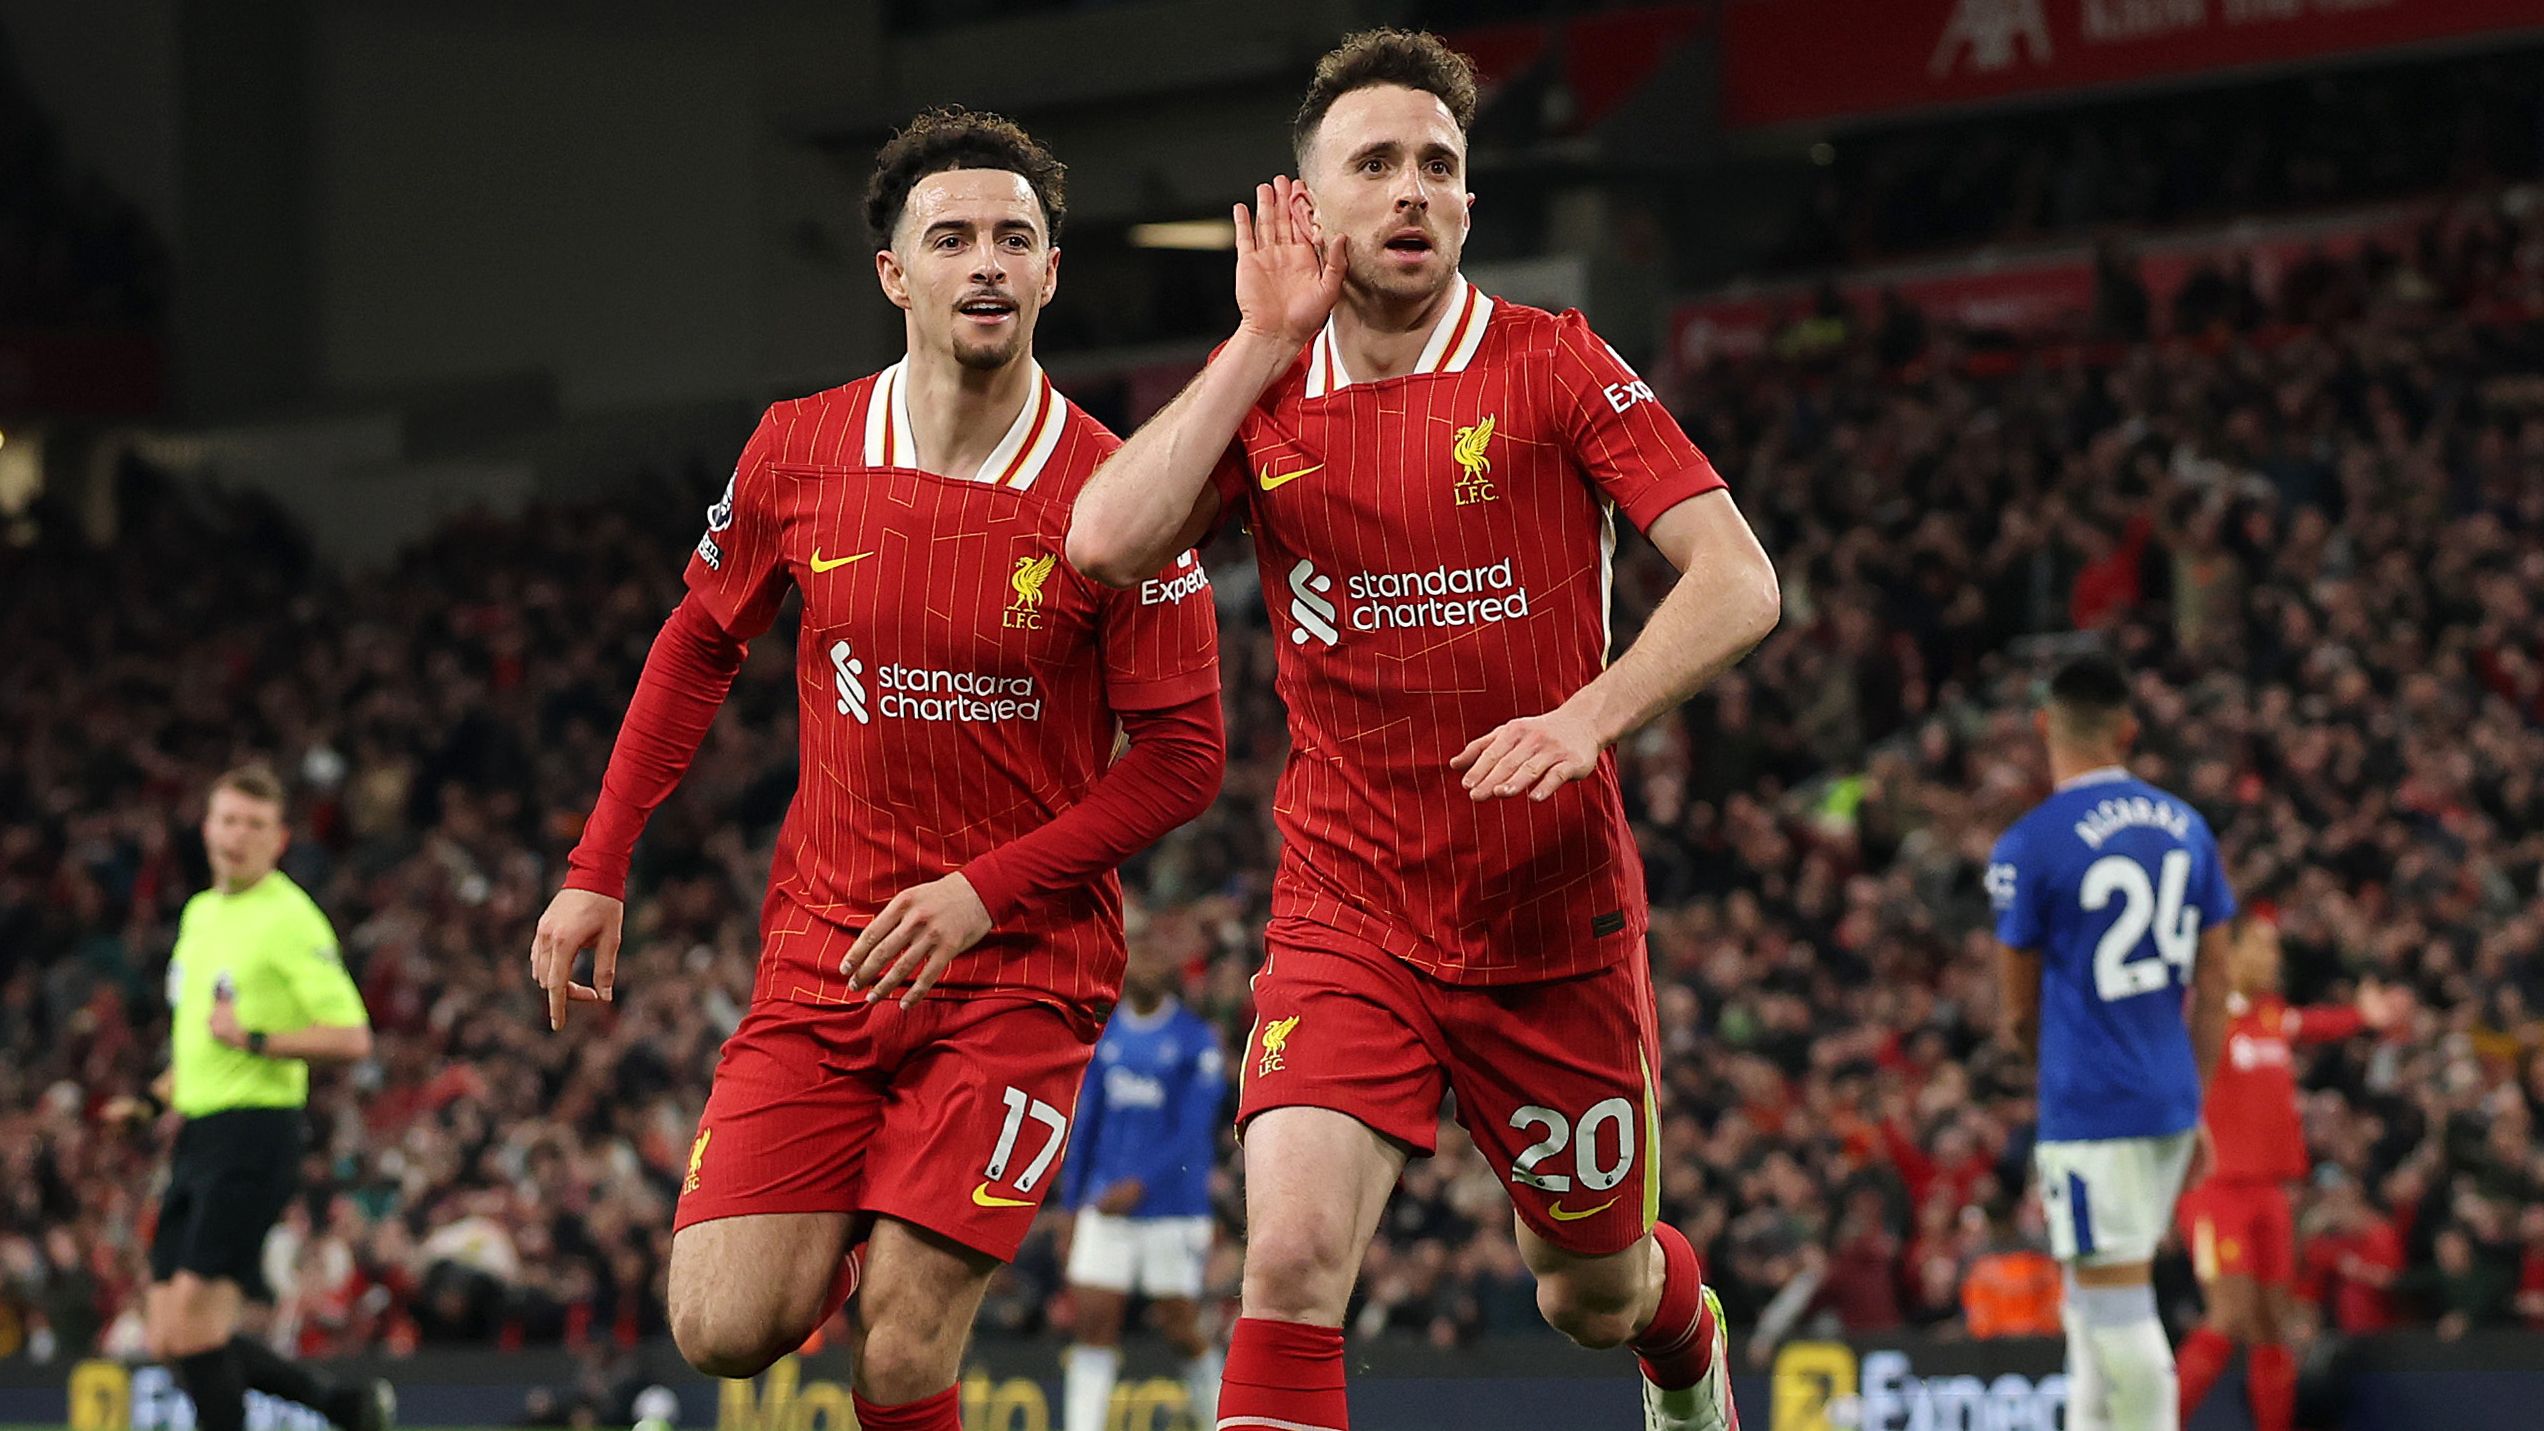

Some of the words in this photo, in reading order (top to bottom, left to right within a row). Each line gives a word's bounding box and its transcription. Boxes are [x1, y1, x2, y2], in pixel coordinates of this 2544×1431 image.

[1602, 379, 1656, 414] Exp
[1348, 556, 1513, 600] standard
[1352, 586, 1529, 631] chartered
[878, 662, 1034, 697] standard
[879, 692, 1041, 724] chartered
[2079, 848, 2201, 1002] 24
[984, 1085, 1068, 1194] 17
[1508, 1096, 1635, 1193] 20
